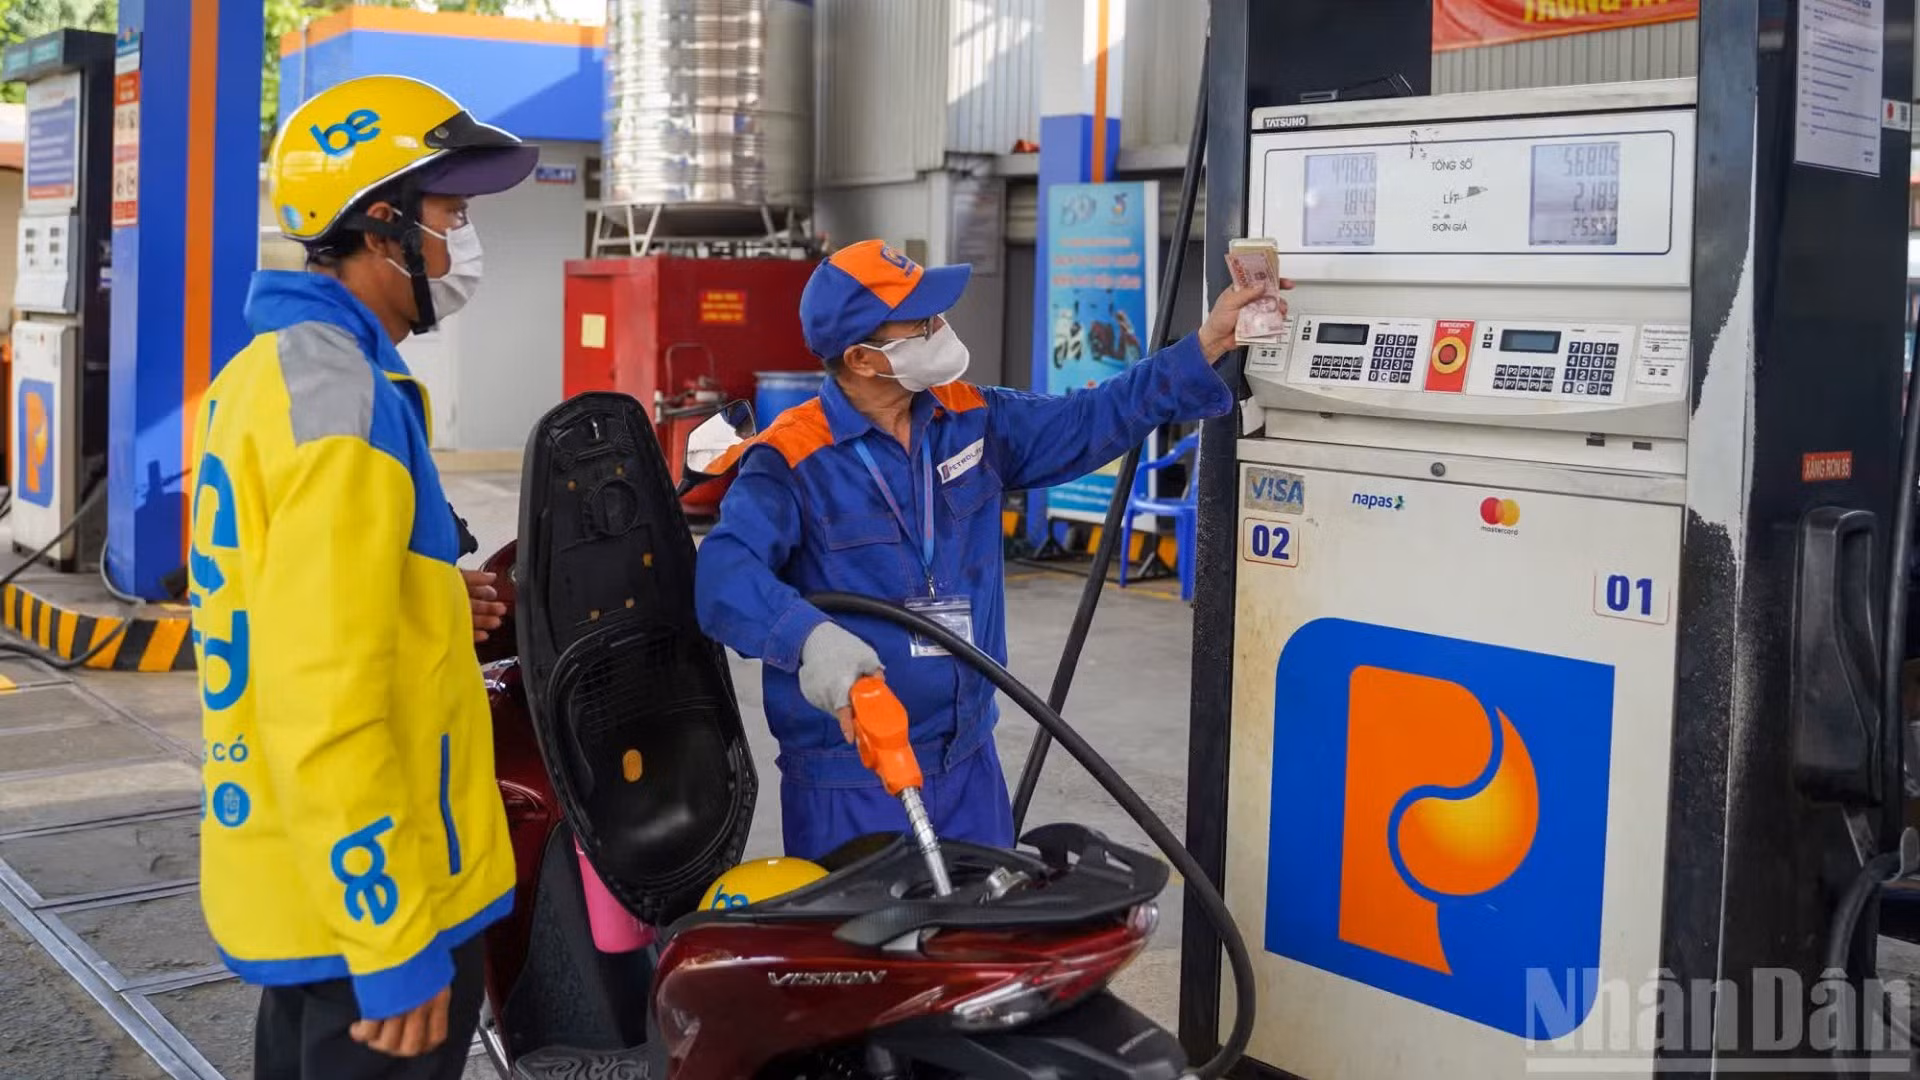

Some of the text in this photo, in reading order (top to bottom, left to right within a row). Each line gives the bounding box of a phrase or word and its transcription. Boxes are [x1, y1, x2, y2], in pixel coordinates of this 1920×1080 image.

[1265, 116, 1306, 127] TATSUNO
[310, 109, 380, 156] be
[1377, 336, 1384, 345] 7
[1388, 336, 1394, 344] 8
[1399, 336, 1405, 345] 9
[1386, 348, 1392, 356] 5
[1396, 348, 1402, 357] 6
[1572, 343, 1579, 352] 7
[1584, 344, 1590, 352] 8
[1597, 344, 1603, 354] 9
[1373, 360, 1378, 368] 1
[1383, 360, 1389, 368] 2
[1394, 360, 1400, 370] 3
[1569, 356, 1576, 366] 4
[1582, 357, 1588, 366] 5
[1594, 358, 1600, 366] 6
[1381, 372, 1388, 380] C
[1568, 370, 1573, 378] 1
[1579, 370, 1586, 380] 2
[1592, 371, 1598, 380] 3
[1576, 384, 1584, 392] C
[1252, 476, 1304, 504] VISA
[1352, 493, 1392, 510] napas
[1252, 524, 1290, 560] 02
[1606, 574, 1652, 616] 01
[330, 815, 398, 925] be
[767, 970, 887, 986] VISION
